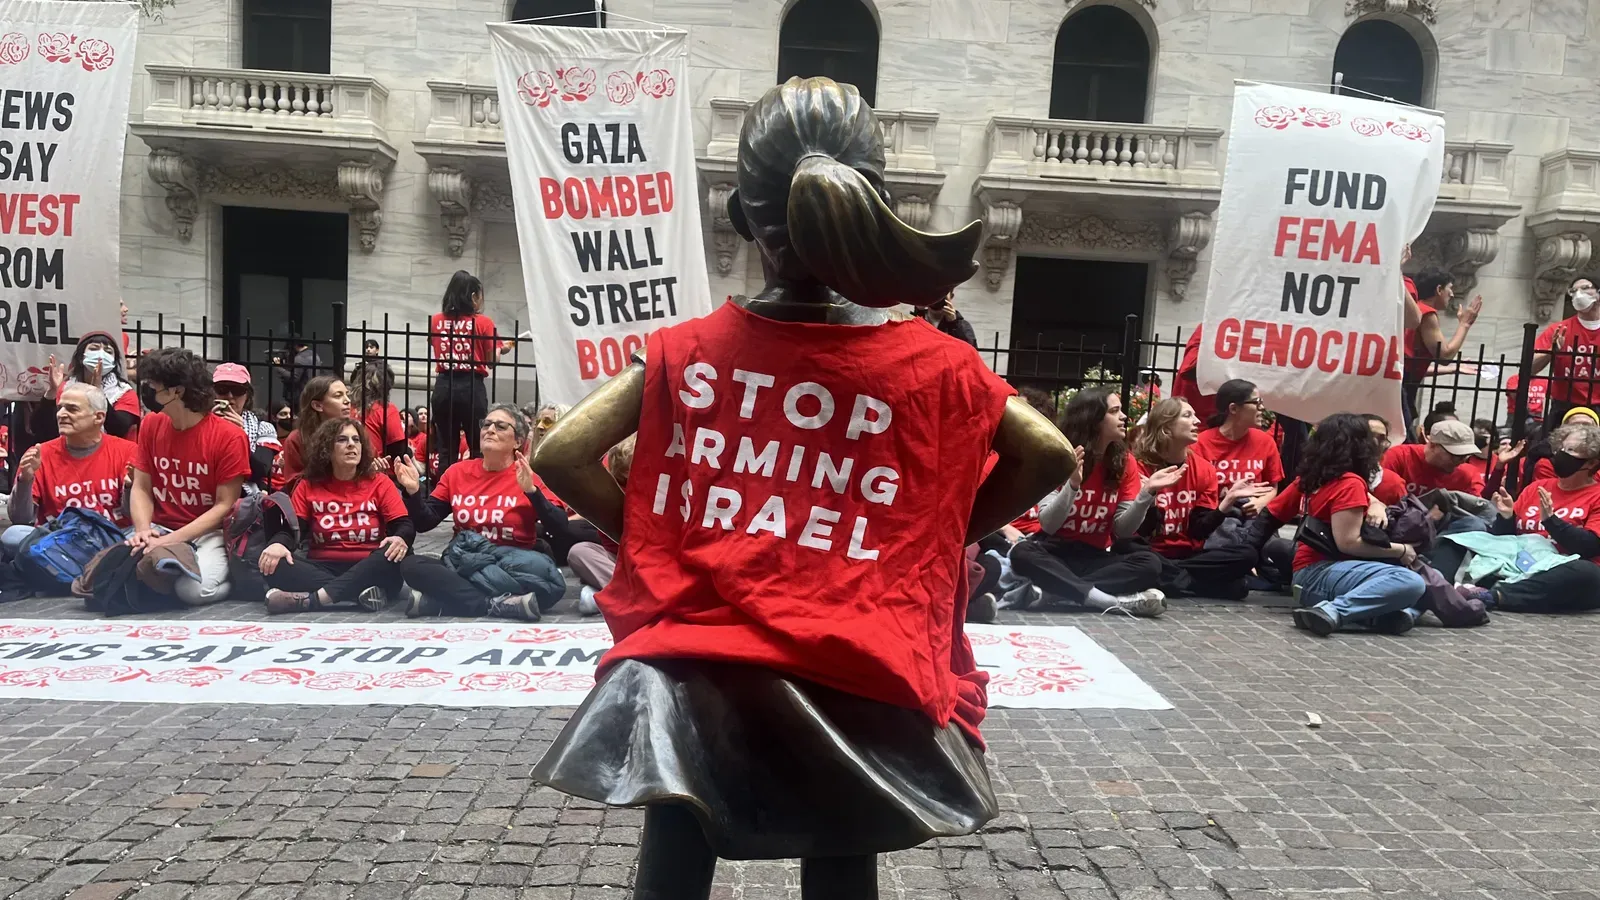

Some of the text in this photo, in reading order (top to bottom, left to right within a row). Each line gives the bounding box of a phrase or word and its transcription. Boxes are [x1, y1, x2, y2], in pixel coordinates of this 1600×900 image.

[0, 89, 75, 131] EWS
[561, 122, 646, 164] GAZA
[539, 171, 674, 219] BOMBED
[1284, 168, 1387, 210] FUND
[571, 227, 663, 272] WALL
[1273, 216, 1381, 265] FEMA
[567, 276, 677, 327] STREET
[1280, 271, 1360, 318] NOT
[436, 320, 473, 330] JEWS
[441, 342, 471, 351] SOP
[1214, 318, 1403, 381] GENOCIDE
[576, 333, 649, 380] BOO
[678, 362, 893, 440] STOP
[188, 462, 208, 475] IN
[664, 423, 900, 506] ARMING
[1211, 459, 1264, 470] OT IN
[55, 478, 119, 497] NOT IN
[1075, 489, 1119, 503] OT IN
[66, 494, 113, 508] OUR
[312, 498, 378, 513] NOT IN
[451, 494, 517, 508] NOT IN
[320, 512, 371, 529] OUR
[457, 508, 504, 524] OUR
[652, 473, 880, 561] ISRAEL
[1525, 506, 1584, 519] SOP
[313, 527, 379, 544] NAME
[481, 526, 514, 540] ME
[1063, 520, 1109, 533] AME
[122, 644, 273, 663] SAY
[272, 646, 448, 664] STOP
